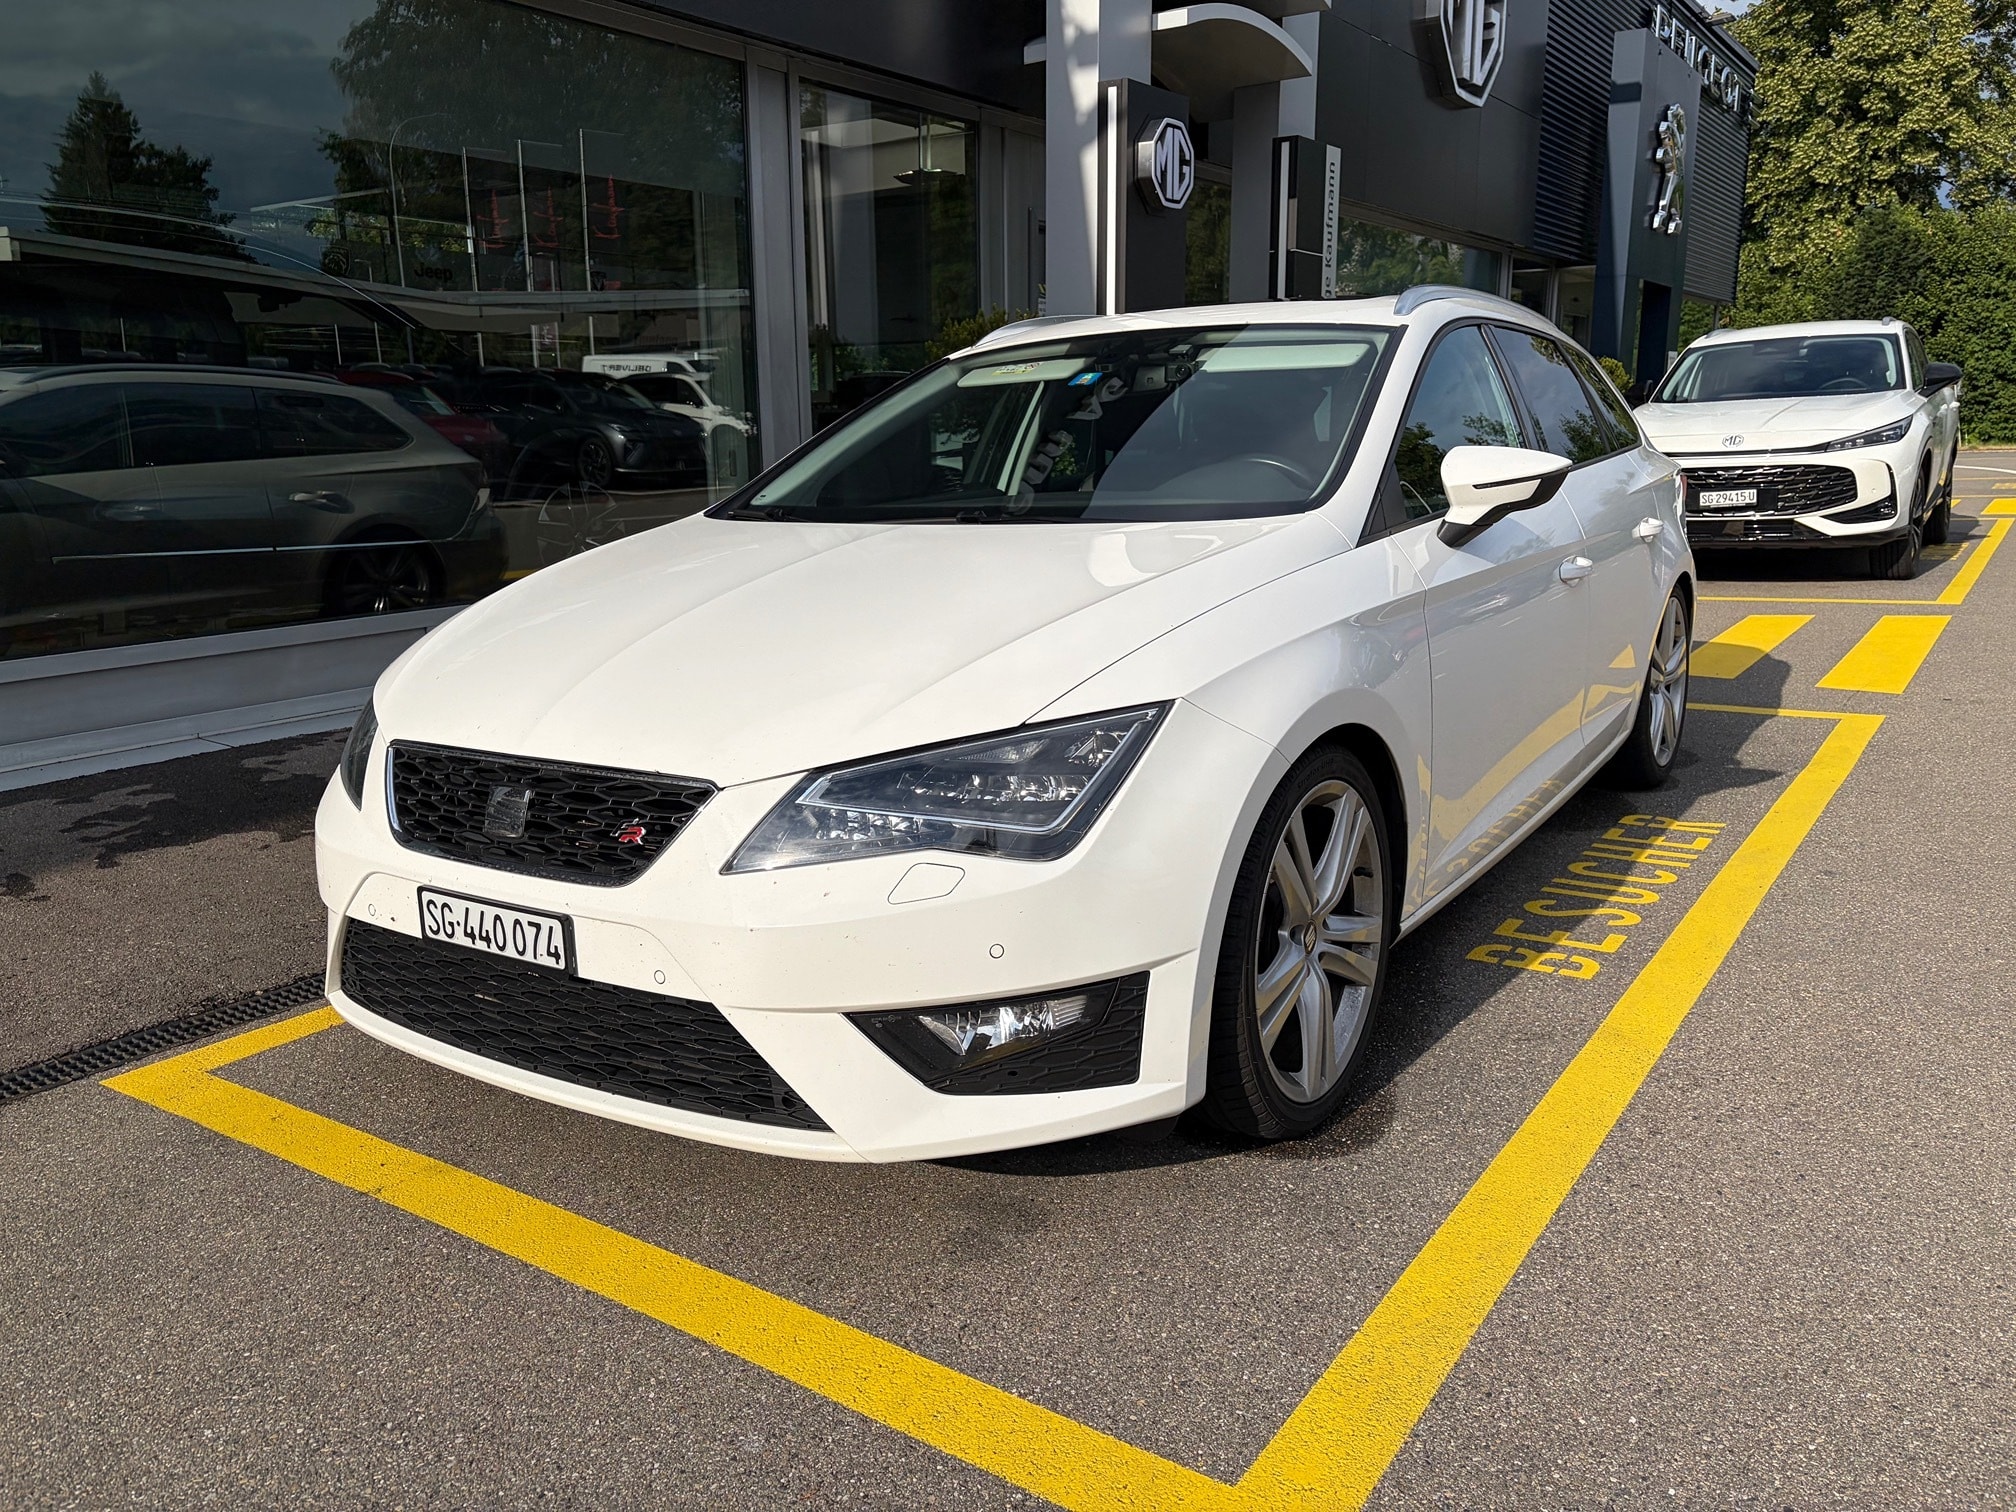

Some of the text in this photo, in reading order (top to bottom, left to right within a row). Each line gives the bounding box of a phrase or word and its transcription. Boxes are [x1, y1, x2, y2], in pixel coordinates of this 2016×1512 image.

[1154, 125, 1192, 201] MG
[1324, 161, 1336, 268] Kaufmann
[414, 262, 453, 283] Jeep
[1464, 813, 1727, 981] BESUCHER
